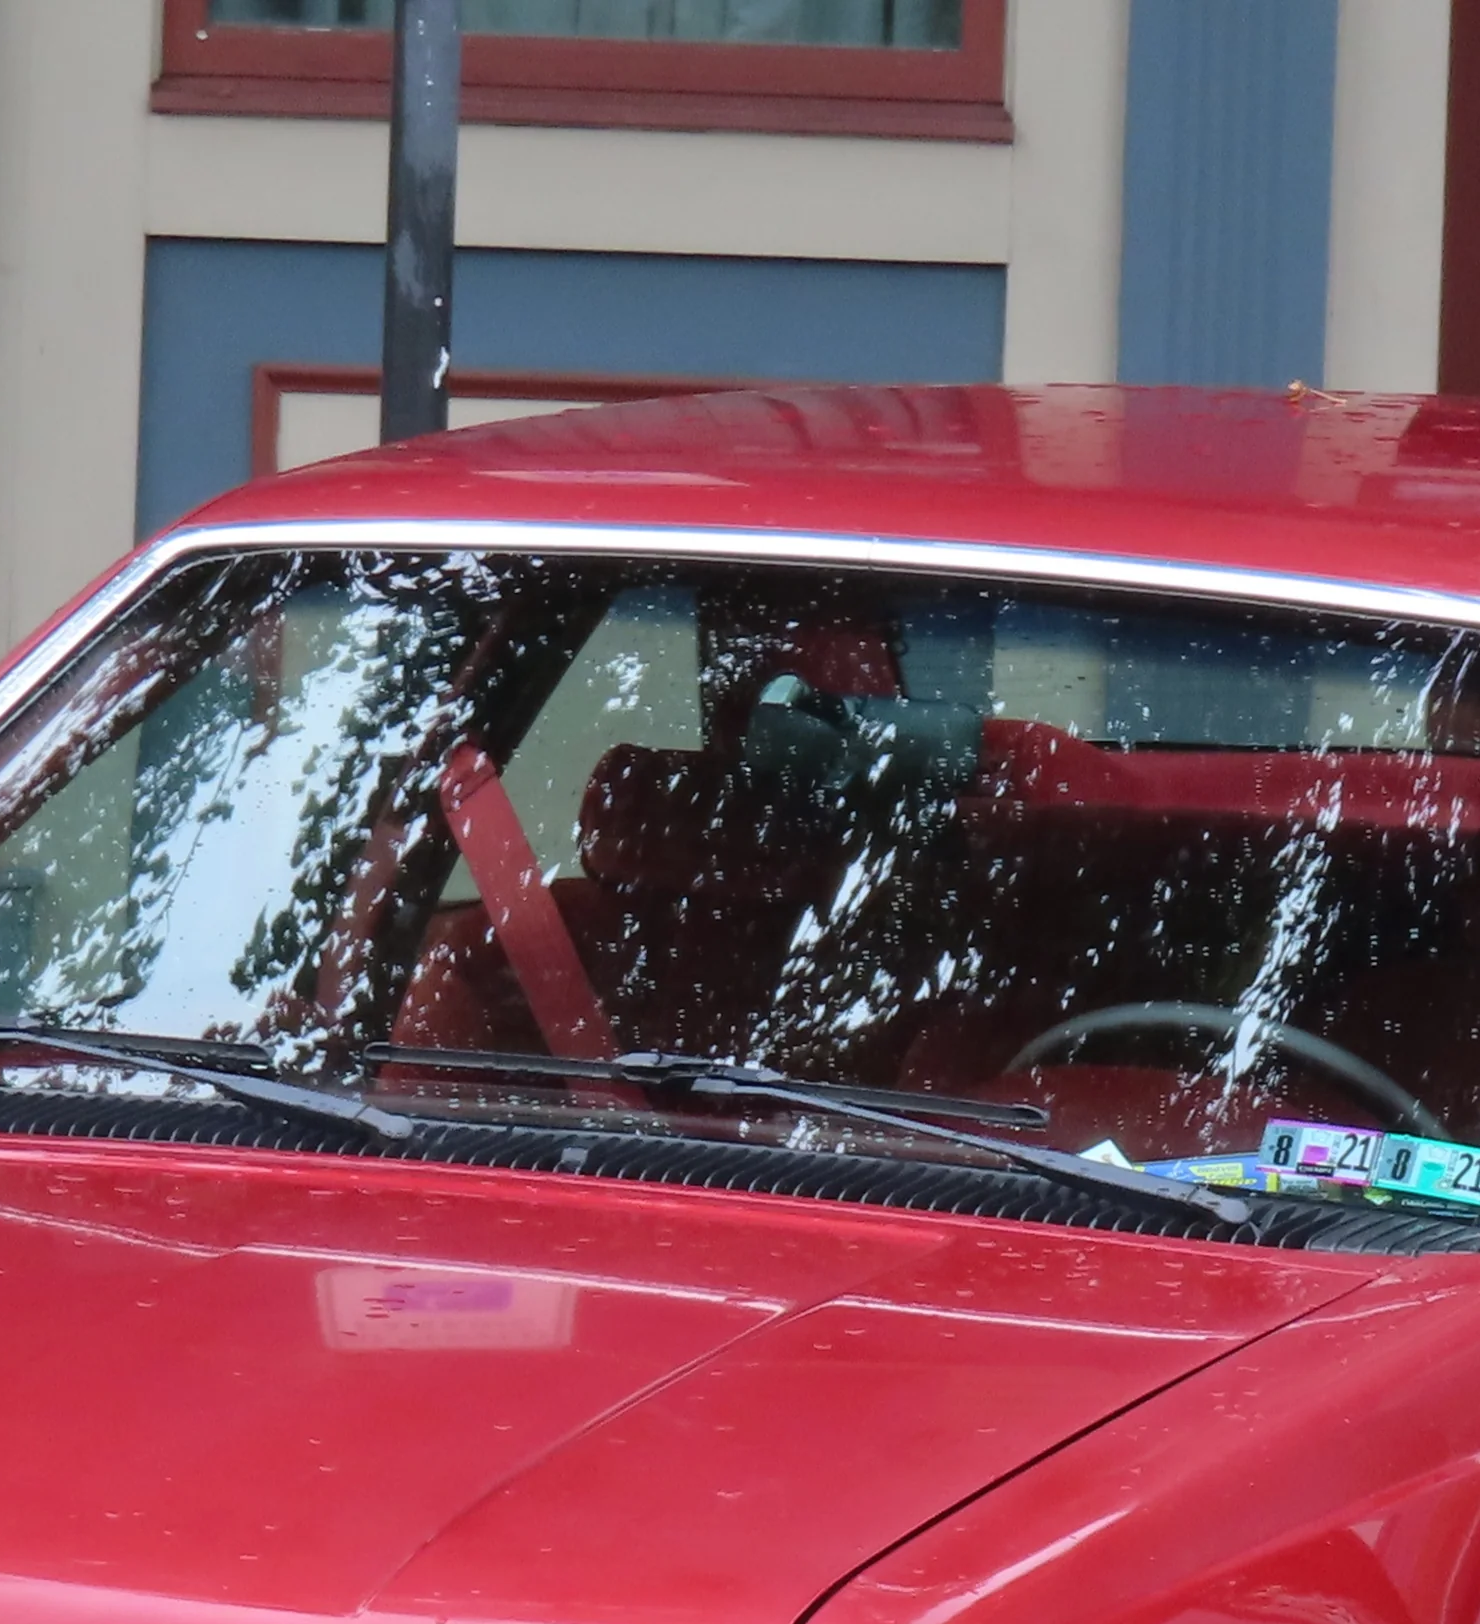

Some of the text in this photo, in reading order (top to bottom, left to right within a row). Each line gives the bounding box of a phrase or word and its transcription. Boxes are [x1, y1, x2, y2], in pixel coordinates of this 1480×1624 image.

[1273, 1135, 1294, 1166] 8
[1337, 1133, 1371, 1172] 21
[1391, 1148, 1412, 1181] 8
